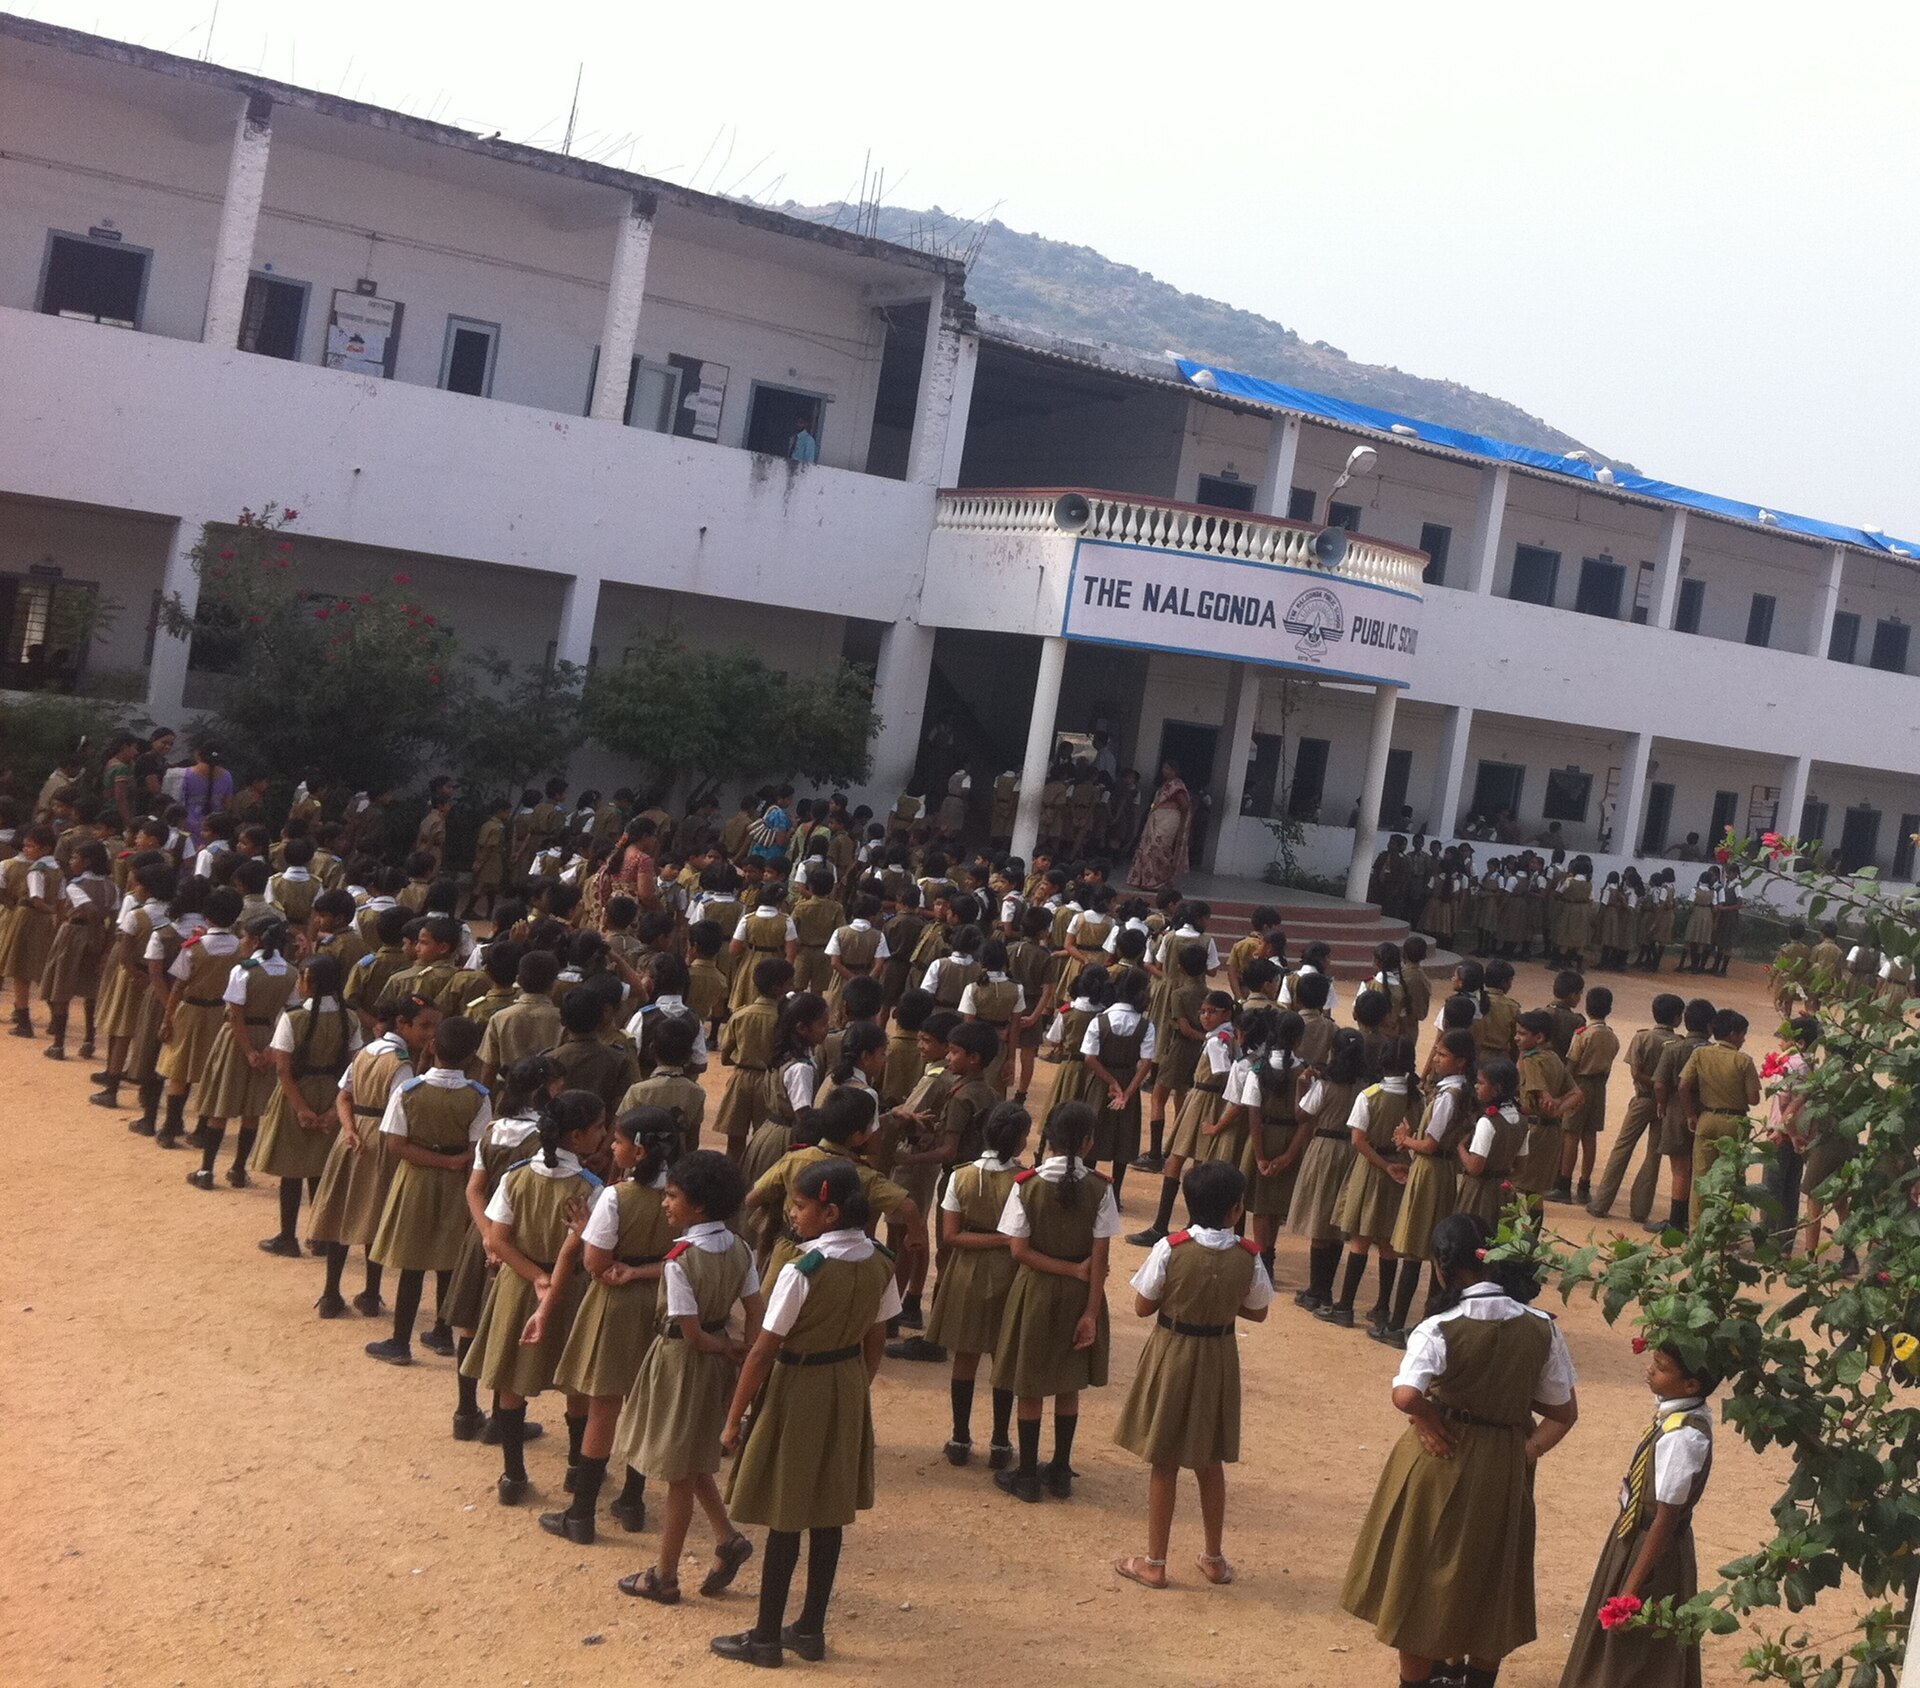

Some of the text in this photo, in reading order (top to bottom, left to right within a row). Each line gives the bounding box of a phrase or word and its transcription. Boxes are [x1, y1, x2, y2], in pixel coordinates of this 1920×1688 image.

[1084, 575, 1276, 629] THE NALGONDA
[1350, 615, 1398, 650] PUBLIC
